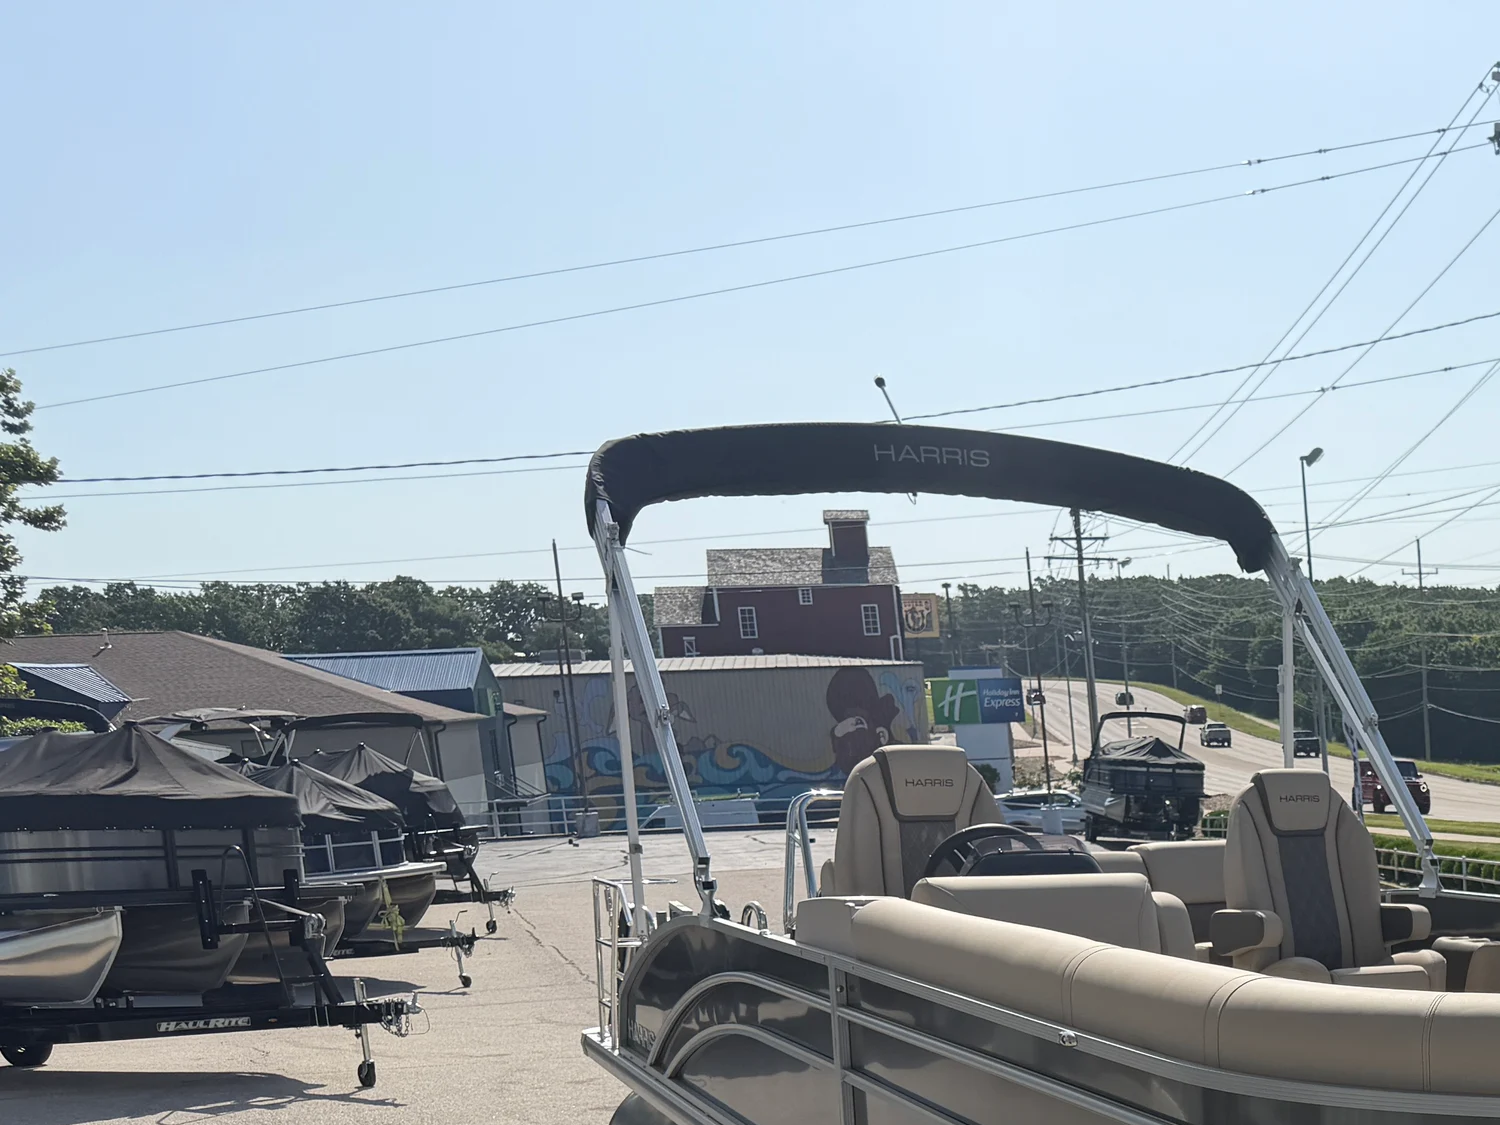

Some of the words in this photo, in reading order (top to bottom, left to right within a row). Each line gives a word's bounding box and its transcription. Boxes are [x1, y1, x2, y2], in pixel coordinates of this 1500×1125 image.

[873, 444, 991, 468] HARRIS
[983, 688, 1008, 698] Holiday
[1008, 688, 1020, 696] Inn
[983, 697, 1021, 710] Express
[905, 778, 954, 787] HARRIS
[1279, 795, 1320, 803] HARRIS
